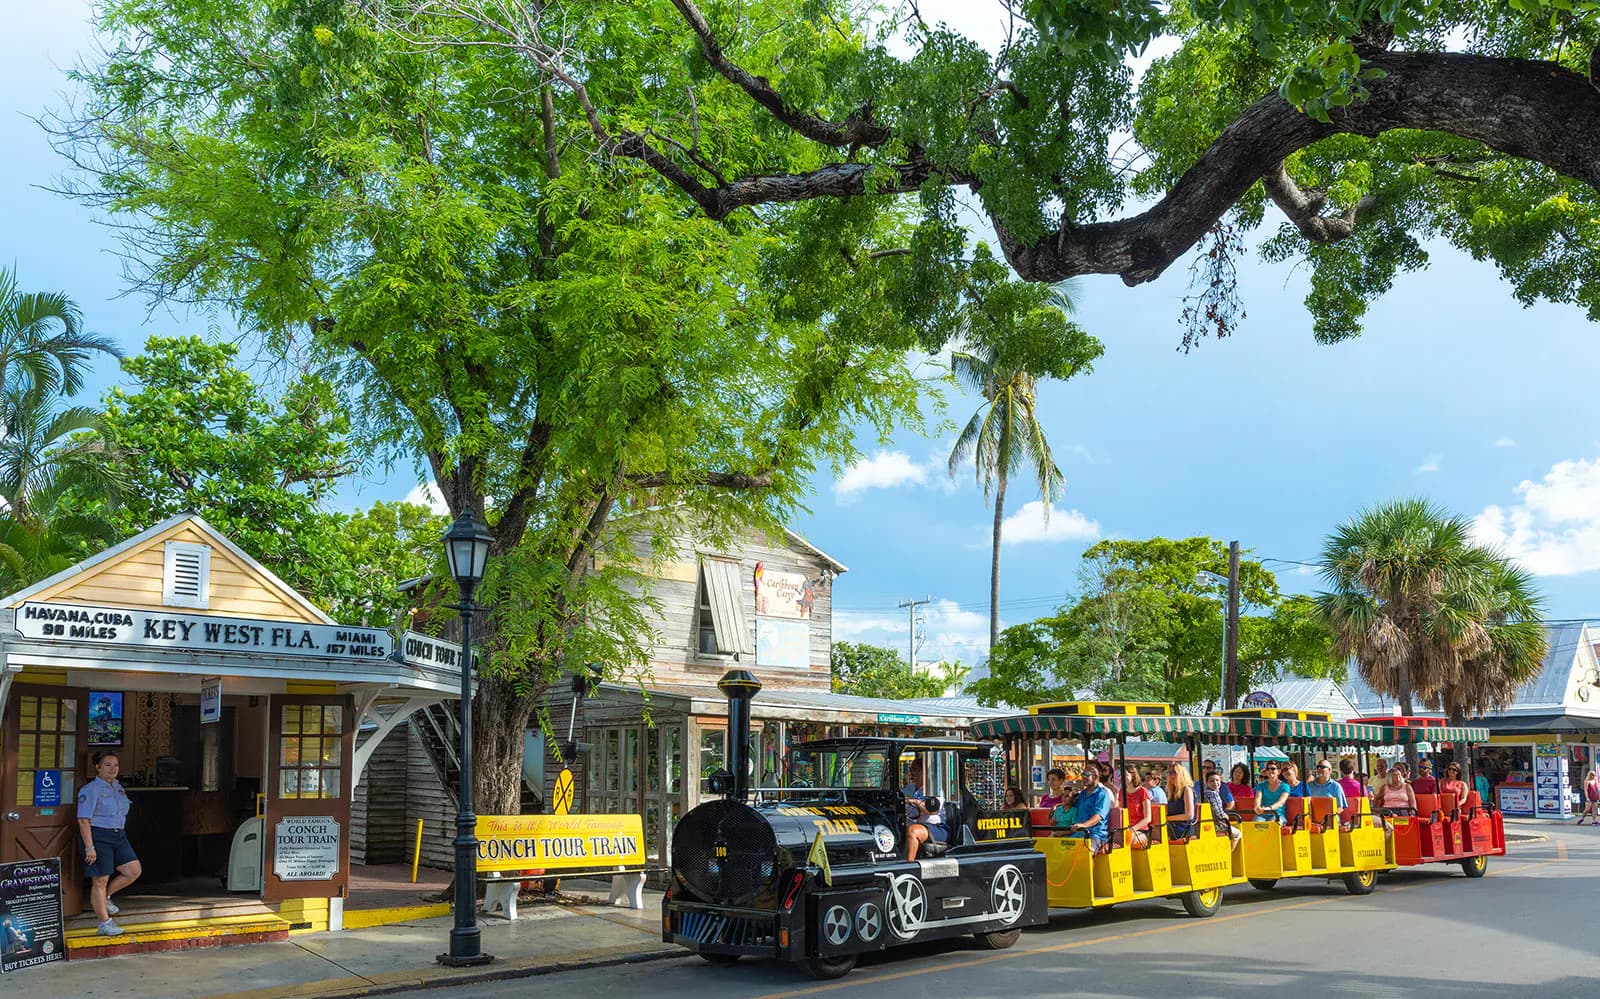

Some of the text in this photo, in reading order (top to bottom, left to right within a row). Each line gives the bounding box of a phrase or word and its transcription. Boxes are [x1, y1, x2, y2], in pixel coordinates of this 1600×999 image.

[766, 578, 800, 591] Caribbean
[144, 619, 196, 641] KEY
[271, 628, 320, 649] FLA.
[336, 631, 376, 645] MIAMI
[349, 645, 385, 657] MILES
[405, 638, 433, 660] CONCH
[434, 645, 456, 666] TOUR
[822, 806, 866, 815] TOUR
[288, 825, 327, 834] CONCH
[488, 820, 508, 832] This
[513, 820, 522, 831] is
[526, 818, 543, 832] it!
[548, 818, 581, 831] World
[812, 818, 860, 836] TRAIN
[977, 818, 1009, 830] OVERSEAS
[277, 835, 337, 844] TOUR TRAIN
[478, 835, 637, 859] CONCH TOUR TRAIN
[13, 865, 46, 877] GHOSTS
[0, 873, 59, 889] GRAVESTONES
[4, 951, 63, 971] BUY TICKETS HERE
